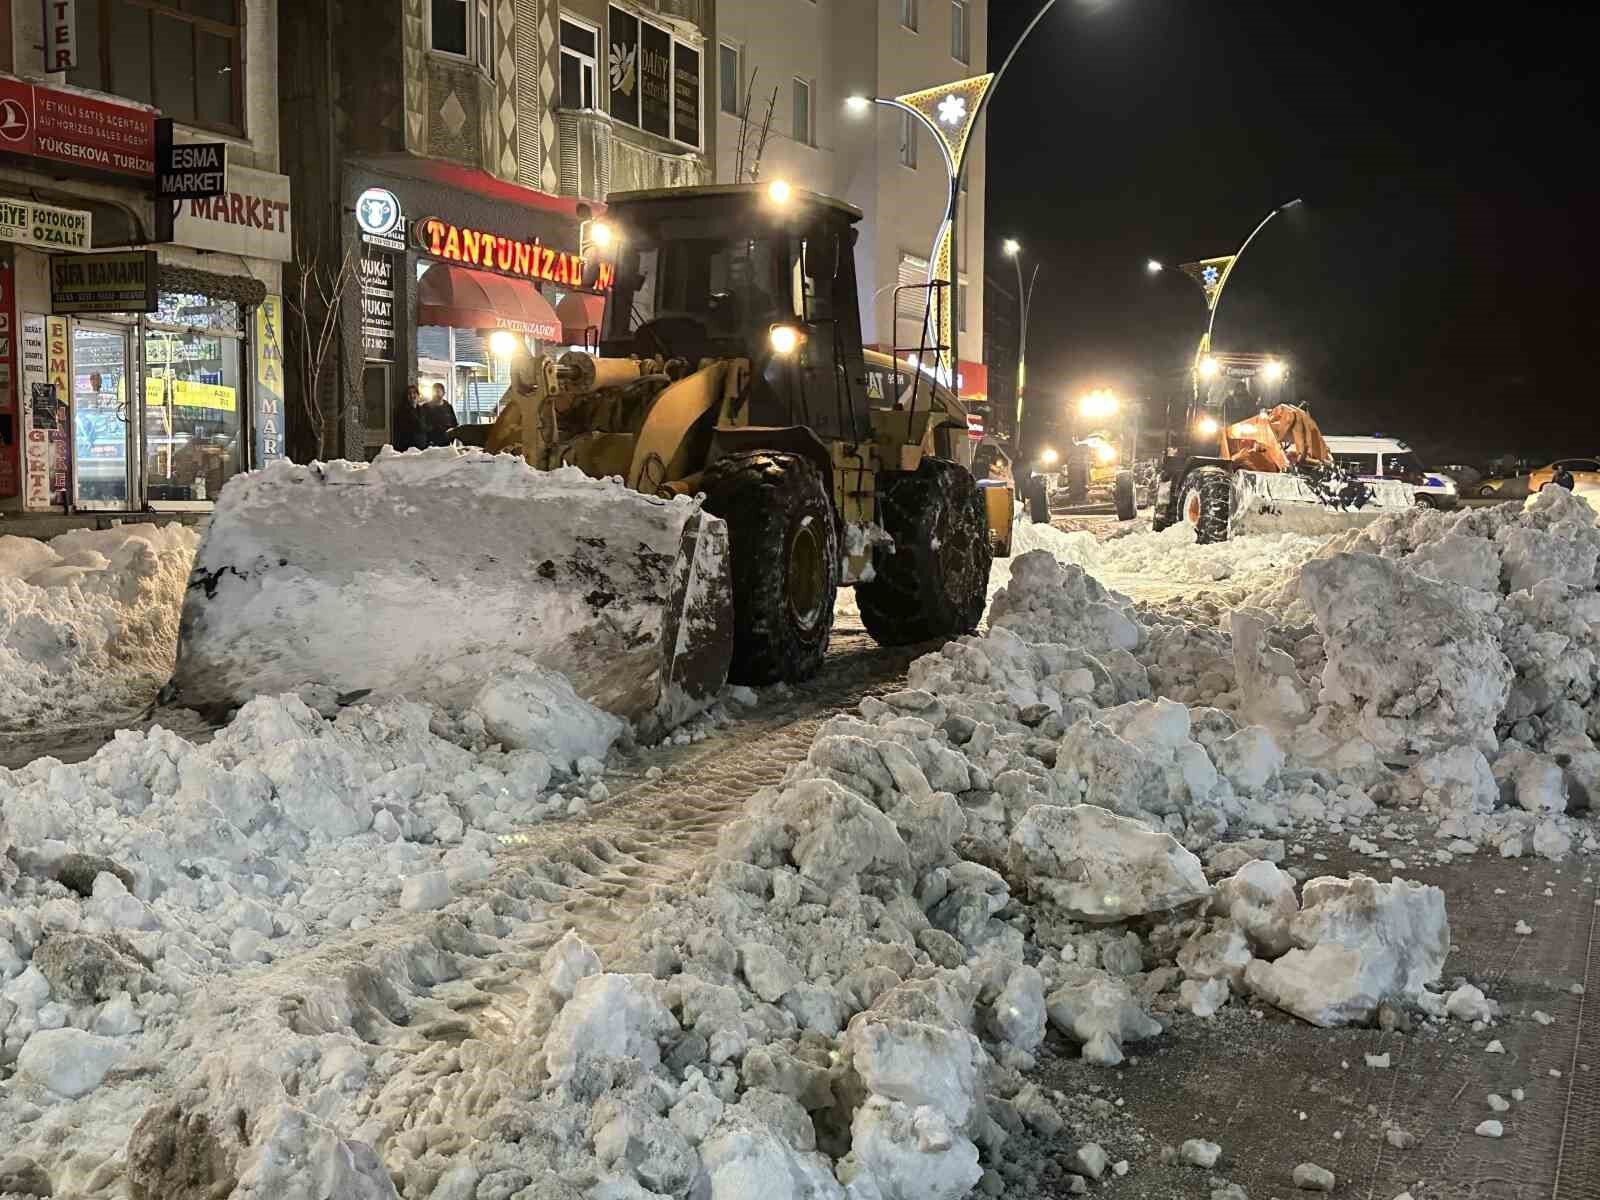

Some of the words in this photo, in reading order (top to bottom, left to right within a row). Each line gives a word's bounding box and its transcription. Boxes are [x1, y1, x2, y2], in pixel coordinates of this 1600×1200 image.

[38, 136, 110, 164] YÜKSEKOVA
[171, 148, 219, 169] ESMA
[161, 172, 224, 193] MARKET
[190, 194, 289, 233] MARKET
[427, 219, 613, 290] TANTUNİZADM
[865, 371, 884, 399] AT
